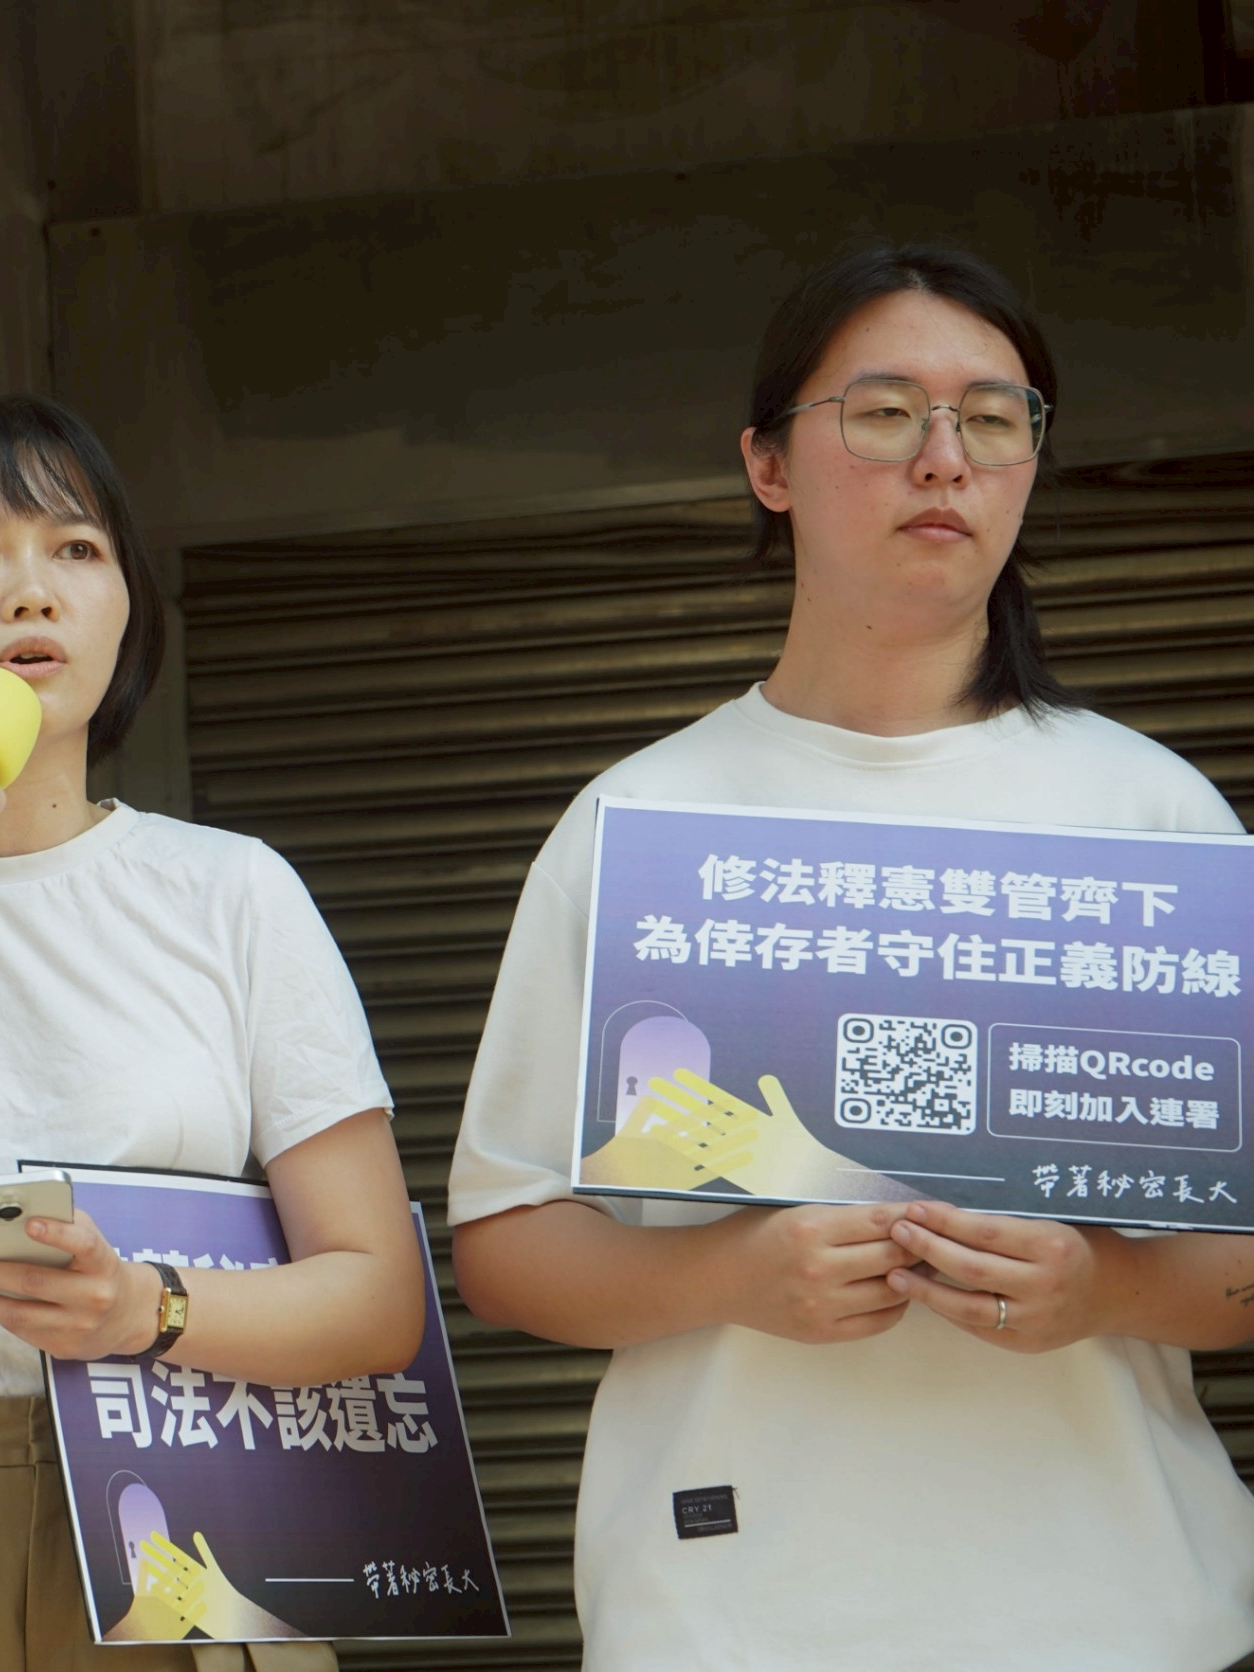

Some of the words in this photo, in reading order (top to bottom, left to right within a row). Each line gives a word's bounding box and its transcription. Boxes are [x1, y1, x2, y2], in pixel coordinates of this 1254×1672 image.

[698, 853, 1178, 927] 修法釋憲雙管齊下
[633, 914, 1242, 998] 為倖存者守住正義防線
[1008, 1042, 1216, 1082] 掃描QRcode
[1008, 1088, 1220, 1130] 即刻加入連署
[1031, 1163, 1238, 1204] 帶著秘密長大
[87, 1360, 439, 1454] 司法不該遺忘
